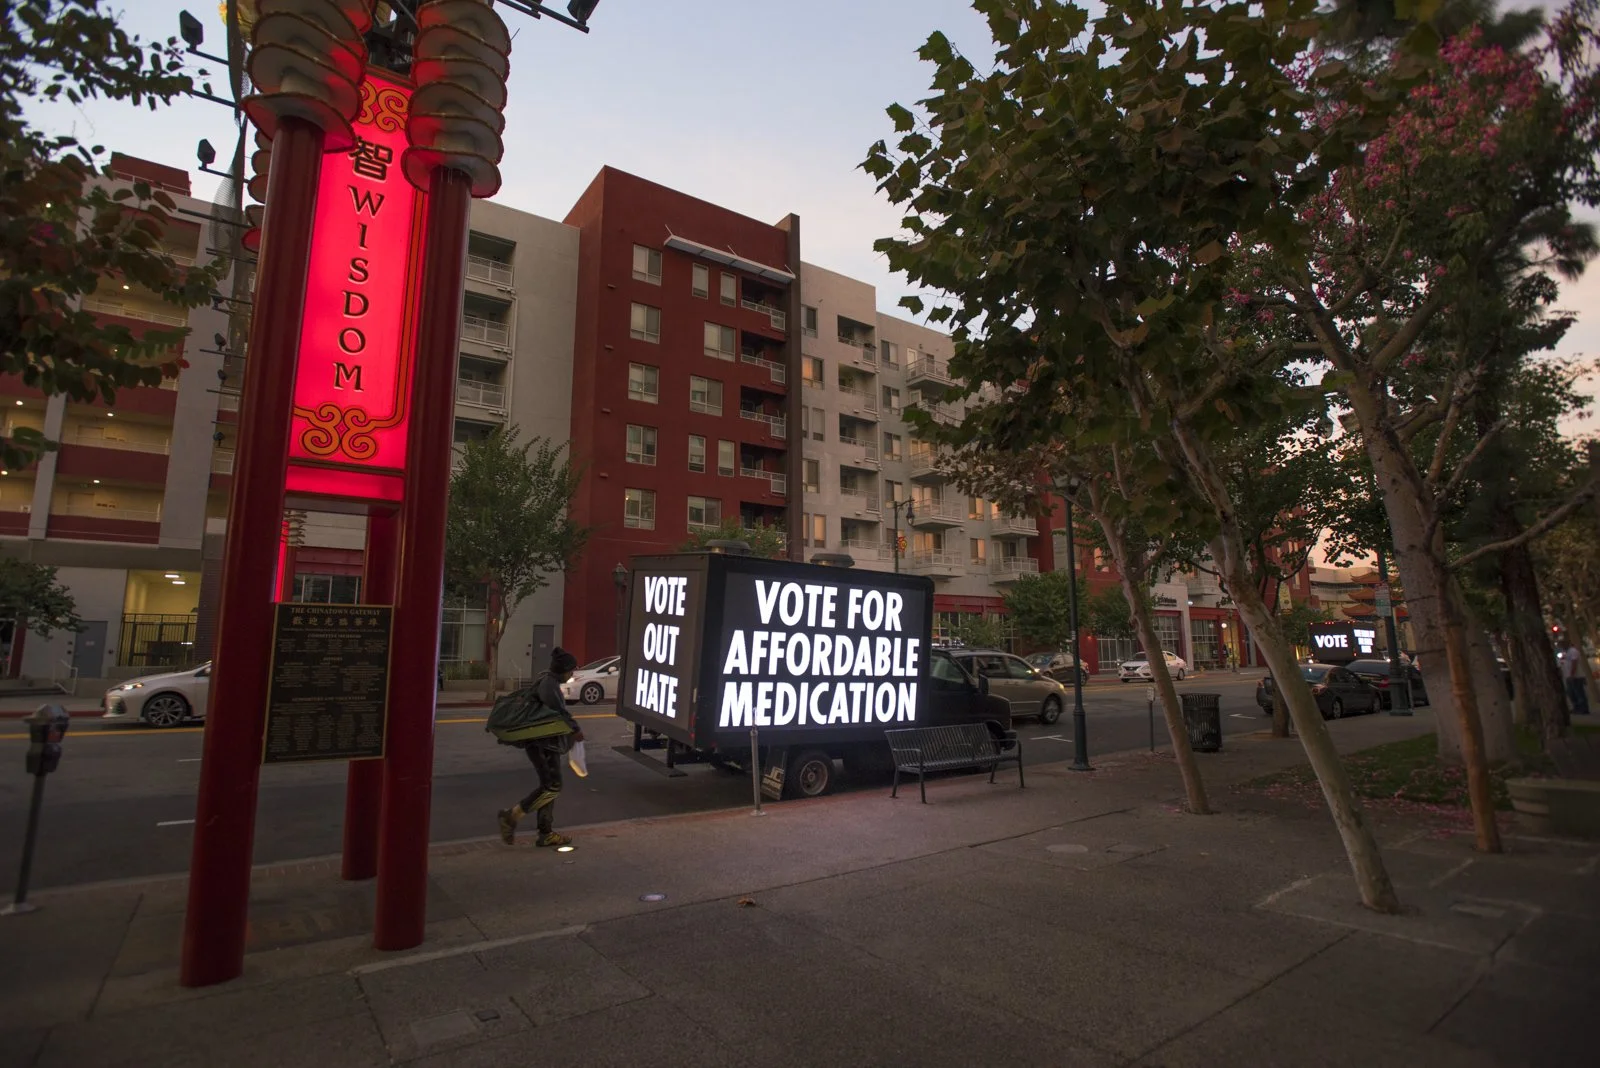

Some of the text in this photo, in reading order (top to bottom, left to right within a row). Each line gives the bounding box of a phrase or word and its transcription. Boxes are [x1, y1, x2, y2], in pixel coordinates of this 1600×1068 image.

[347, 134, 394, 183] 智
[332, 183, 386, 393] WISDOM
[350, 608, 381, 616] GATEWAY
[644, 576, 688, 616] VOTE
[755, 579, 904, 631] VOTE FOR
[643, 622, 680, 666] OUT
[723, 629, 920, 677] AFFORDABLE
[1314, 634, 1349, 648] VOTE
[635, 668, 679, 719] HATE
[718, 681, 918, 728] MEDICATION
